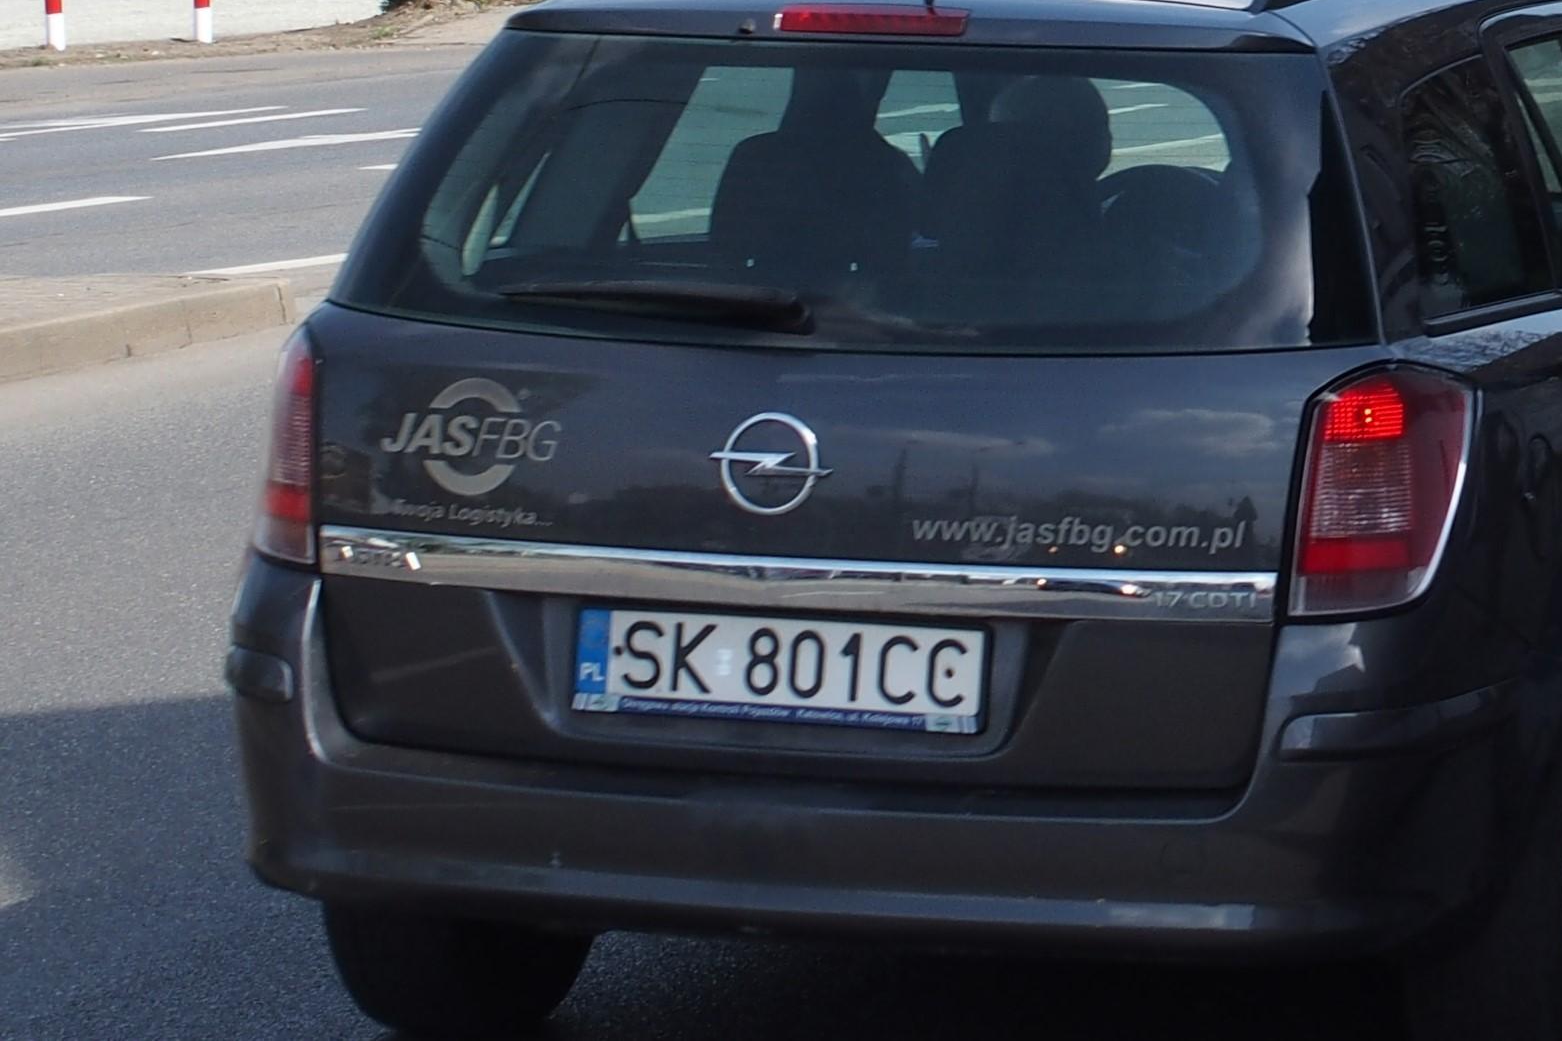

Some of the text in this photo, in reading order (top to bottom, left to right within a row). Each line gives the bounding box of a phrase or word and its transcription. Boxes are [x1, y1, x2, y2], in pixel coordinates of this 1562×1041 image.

[912, 515, 1246, 555] www.jasfbg.com.pl
[1188, 590, 1256, 608] CDTI
[579, 662, 604, 681] PL
[622, 621, 969, 708] SK 801CC
